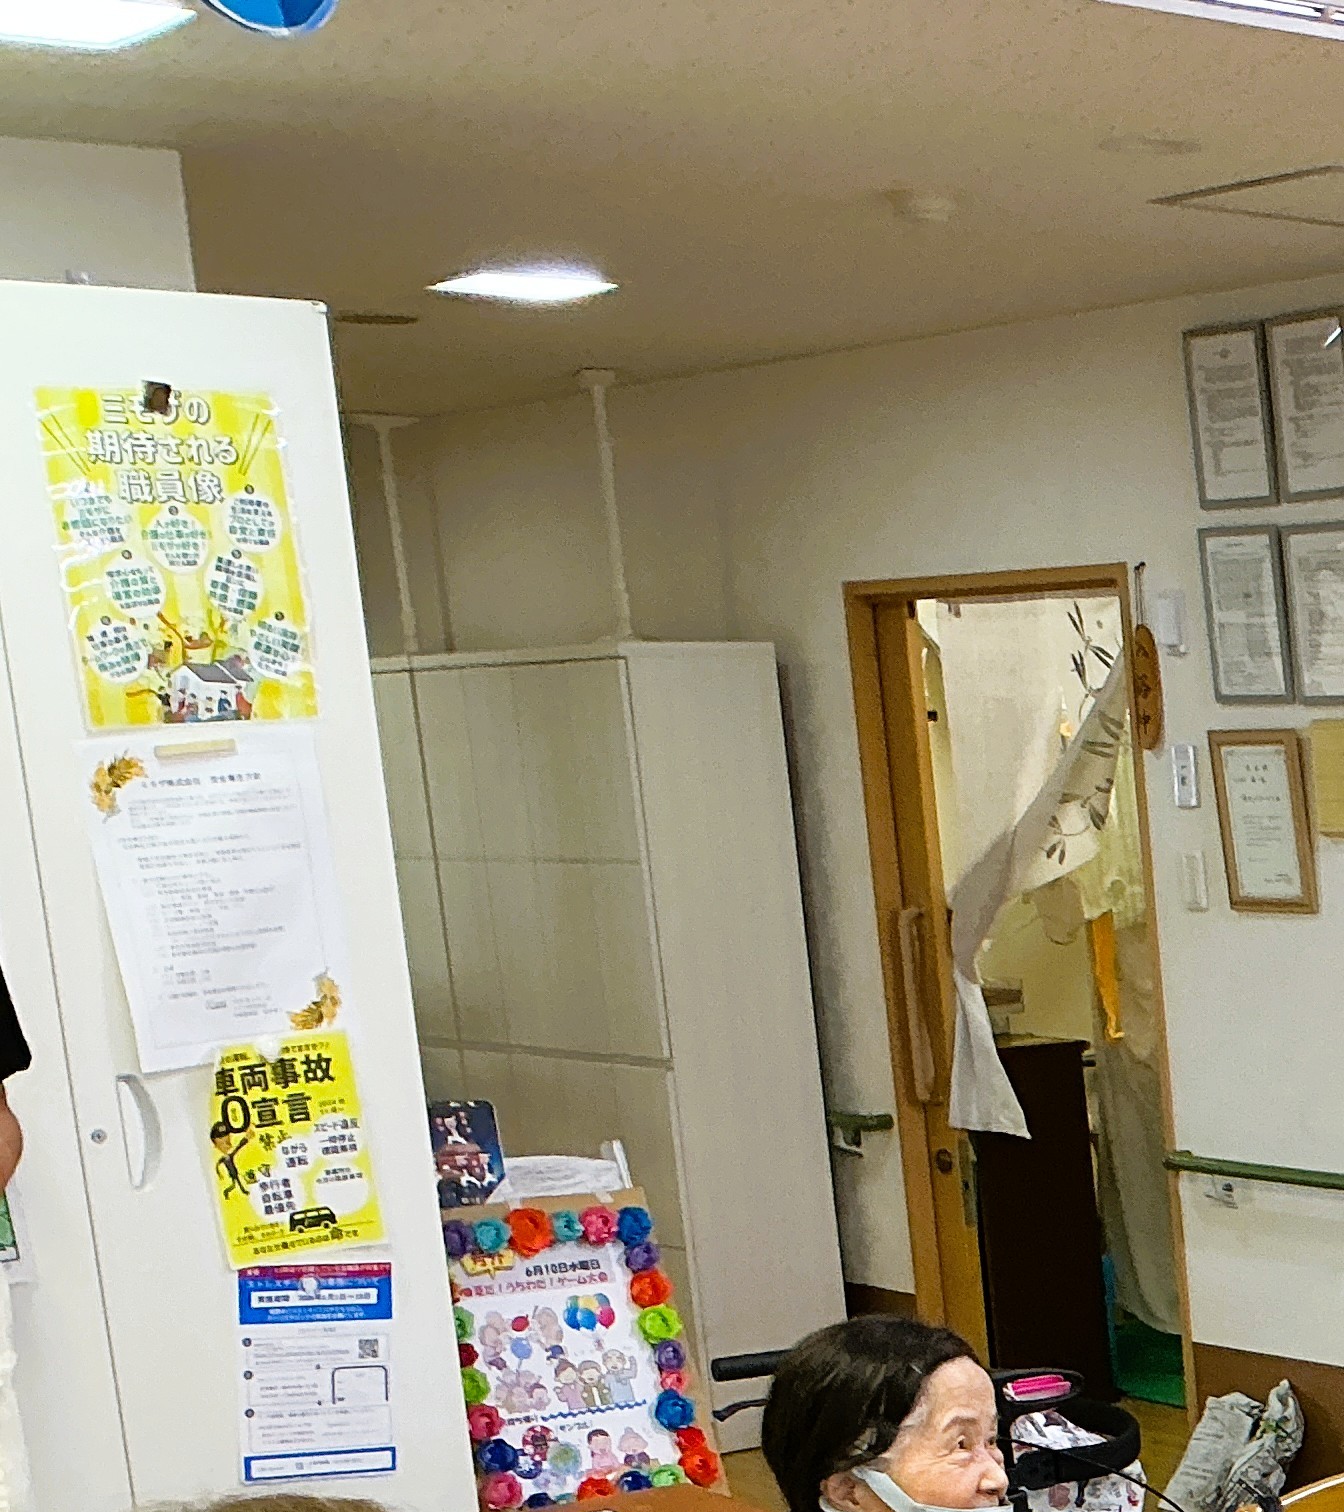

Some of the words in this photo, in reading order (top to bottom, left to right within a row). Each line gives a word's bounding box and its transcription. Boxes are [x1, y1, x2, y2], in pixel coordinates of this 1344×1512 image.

[85, 429, 239, 465] 期待される
[116, 468, 224, 504] 職員像
[215, 1053, 335, 1096] 車両事故
[313, 1118, 360, 1133] スピード違反
[281, 1142, 308, 1156] ながら
[285, 1155, 309, 1168] 運転
[258, 1177, 291, 1192] 歩行者
